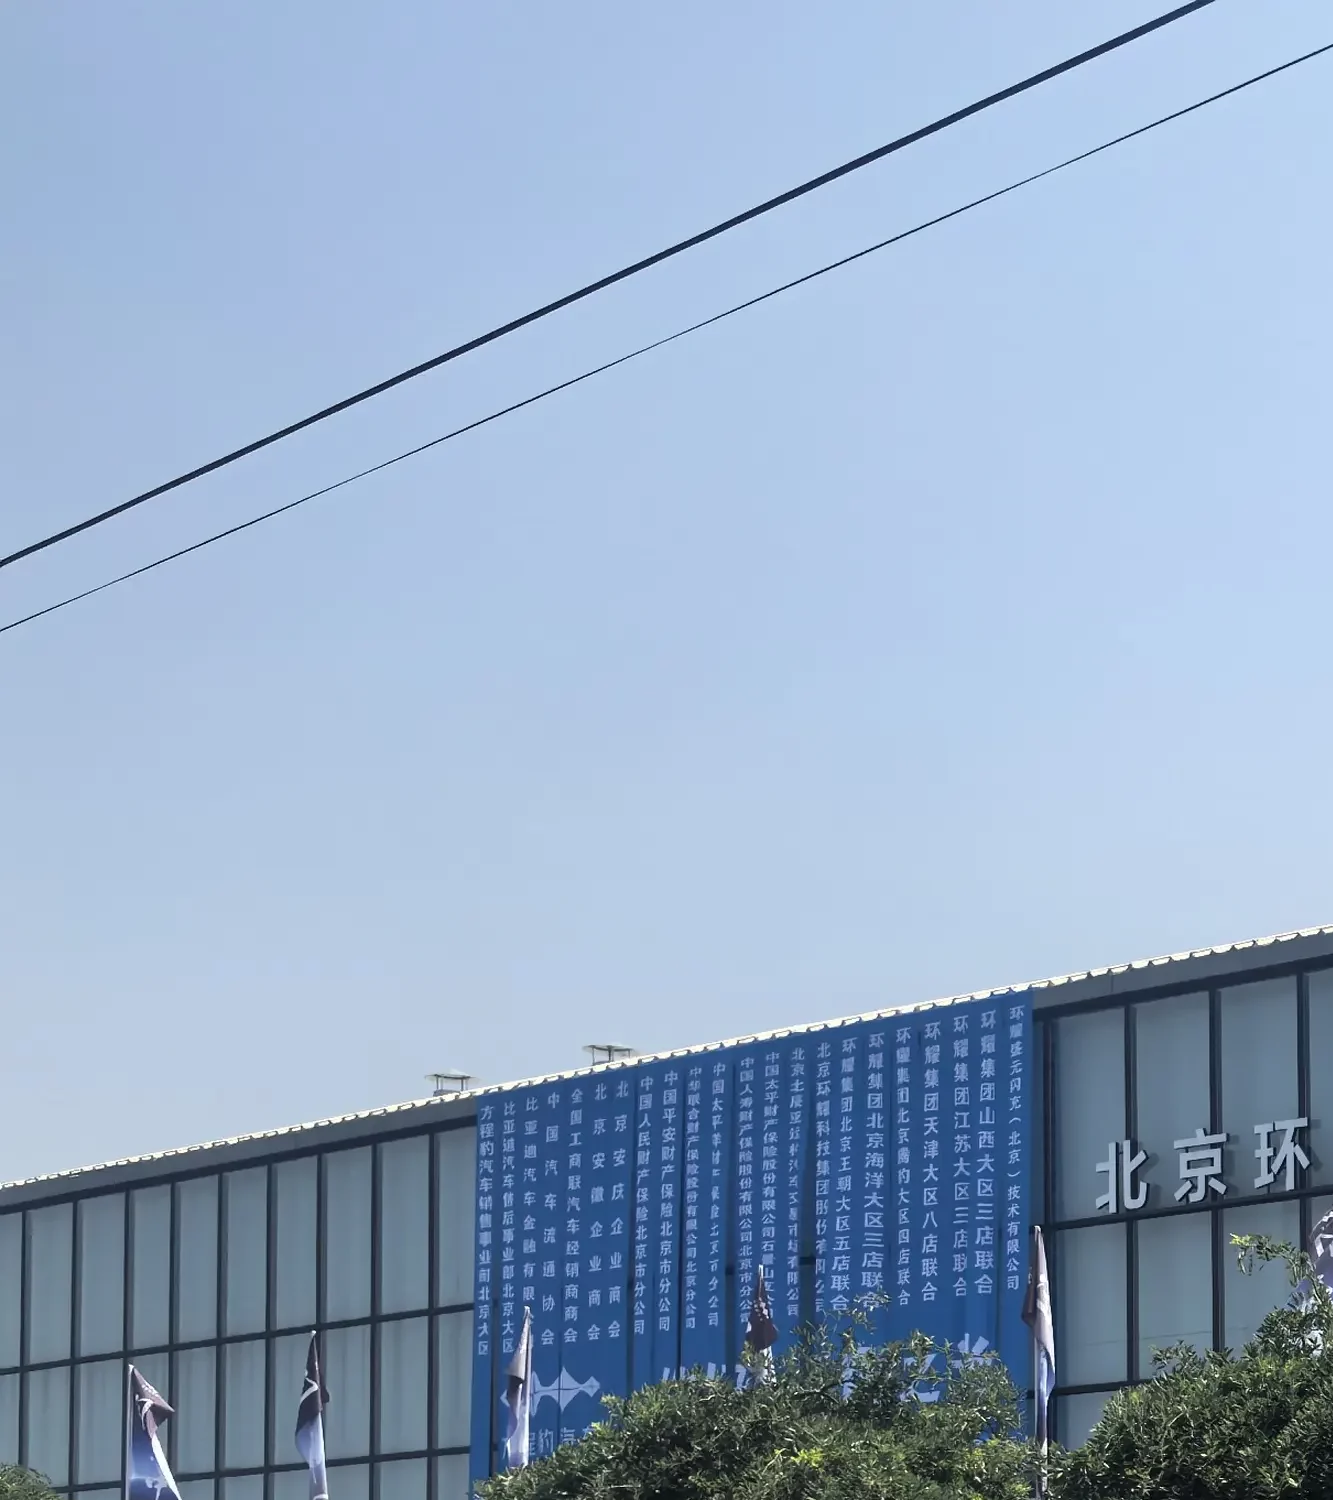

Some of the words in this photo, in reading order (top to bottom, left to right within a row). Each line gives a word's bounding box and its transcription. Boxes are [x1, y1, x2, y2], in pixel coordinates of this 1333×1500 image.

[522, 1097, 539, 1301] 比亚迪汽车金融有限
[541, 1092, 560, 1345] 中国汽车流通协会
[564, 1088, 583, 1343] 全国工商联汽车经销商商会
[587, 1083, 607, 1340] 北京安徽企业商会
[608, 1080, 629, 1338] 北京安庆企业商会
[634, 1076, 653, 1335] 中国人民财产保险北京市分公司
[659, 1070, 678, 1331] 中国平安财产保险北京市分公司
[830, 1037, 858, 1311] 环耀集团北京王朝大区五店联合
[861, 1032, 885, 1308] 环耀集团北京海洋大区三店联合
[922, 1020, 941, 1302] 环耀集团天津大区八店联合
[953, 1015, 971, 1297] 环耀集团江苏大区三店联合
[974, 1010, 997, 1295] 环耀集团山西大区三店联合
